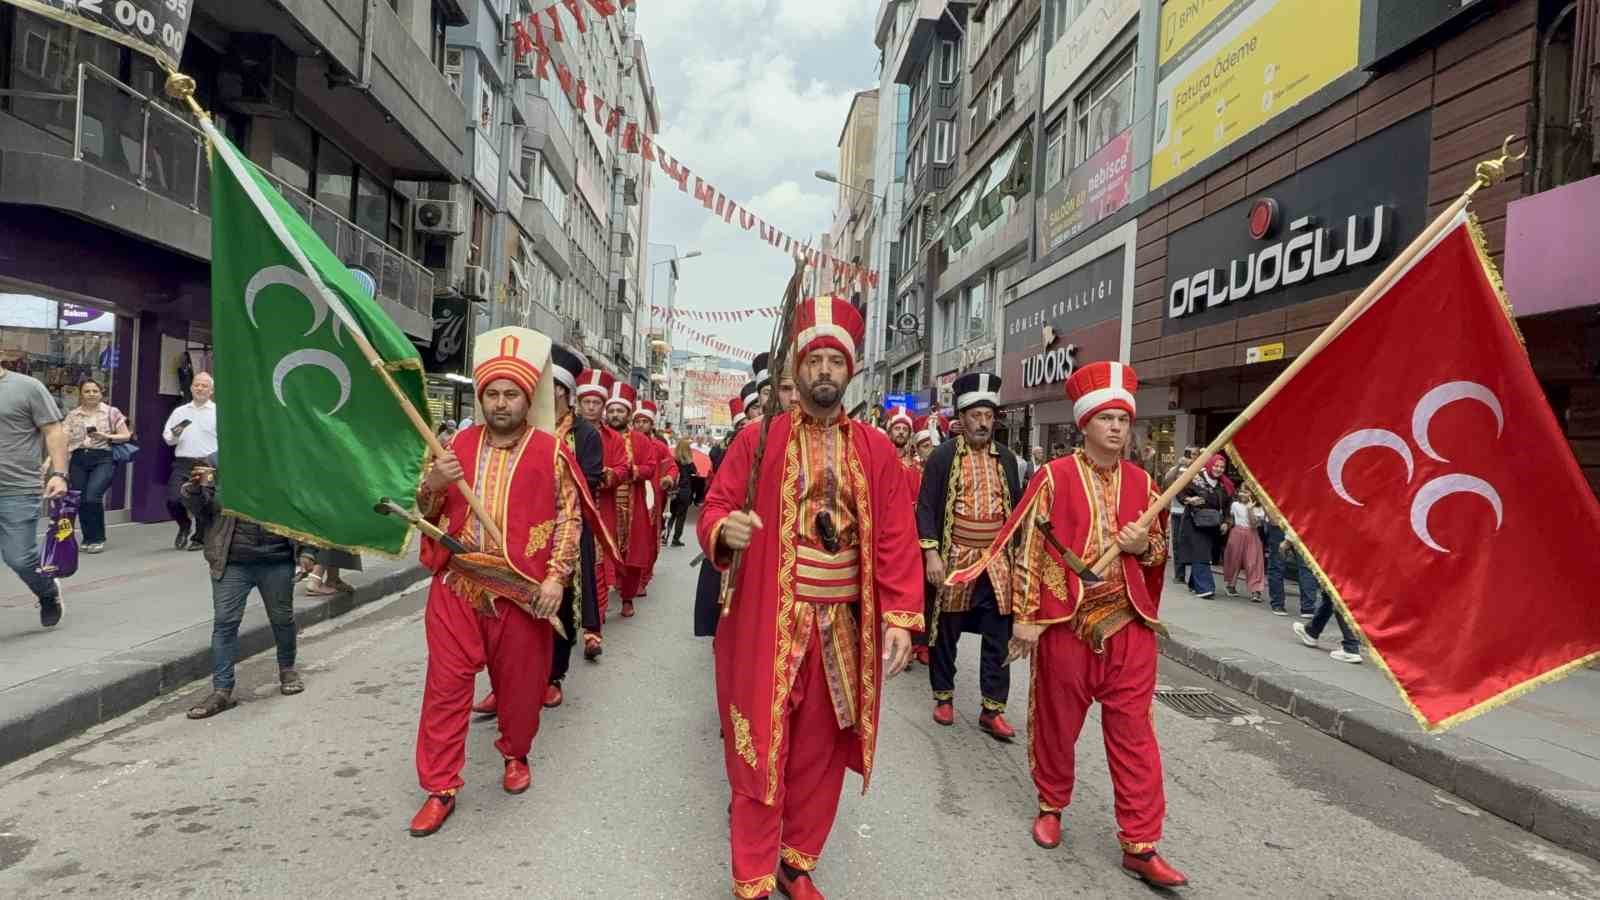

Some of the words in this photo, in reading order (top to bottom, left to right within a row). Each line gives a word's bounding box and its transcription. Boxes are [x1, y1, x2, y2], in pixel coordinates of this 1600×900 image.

[115, 0, 155, 35] 00
[163, 23, 182, 53] 00
[1176, 73, 1211, 108] Fatura
[1213, 36, 1257, 79] Ödeme
[1088, 154, 1128, 194] nebisce
[1168, 205, 1384, 319] OFLUOĞLU
[1020, 344, 1075, 389] TUDORS
